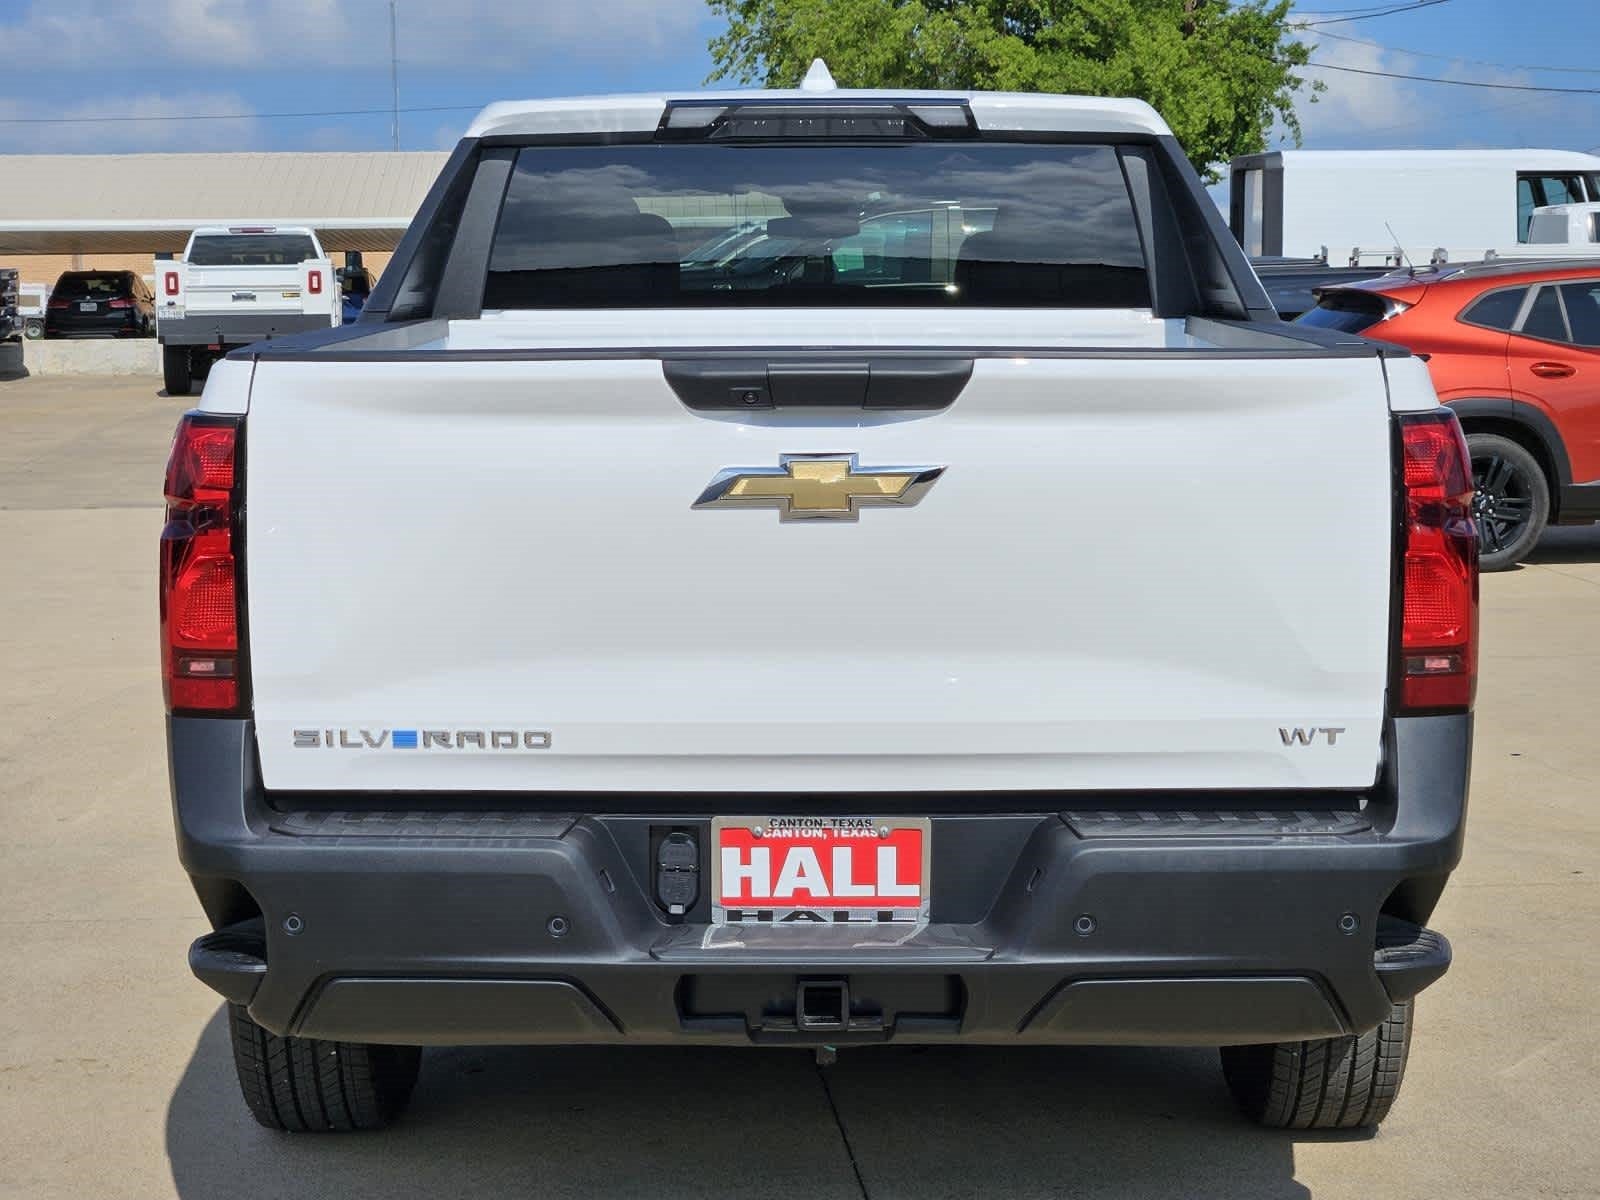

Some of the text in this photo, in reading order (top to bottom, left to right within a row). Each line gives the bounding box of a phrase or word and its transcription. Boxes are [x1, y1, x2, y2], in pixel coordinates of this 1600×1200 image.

[293, 729, 553, 749] SILVERADO
[1278, 727, 1346, 746] WT
[830, 818, 872, 827] TEXAS
[762, 828, 878, 839] CANTON, TEXAS
[721, 847, 920, 897] HALL
